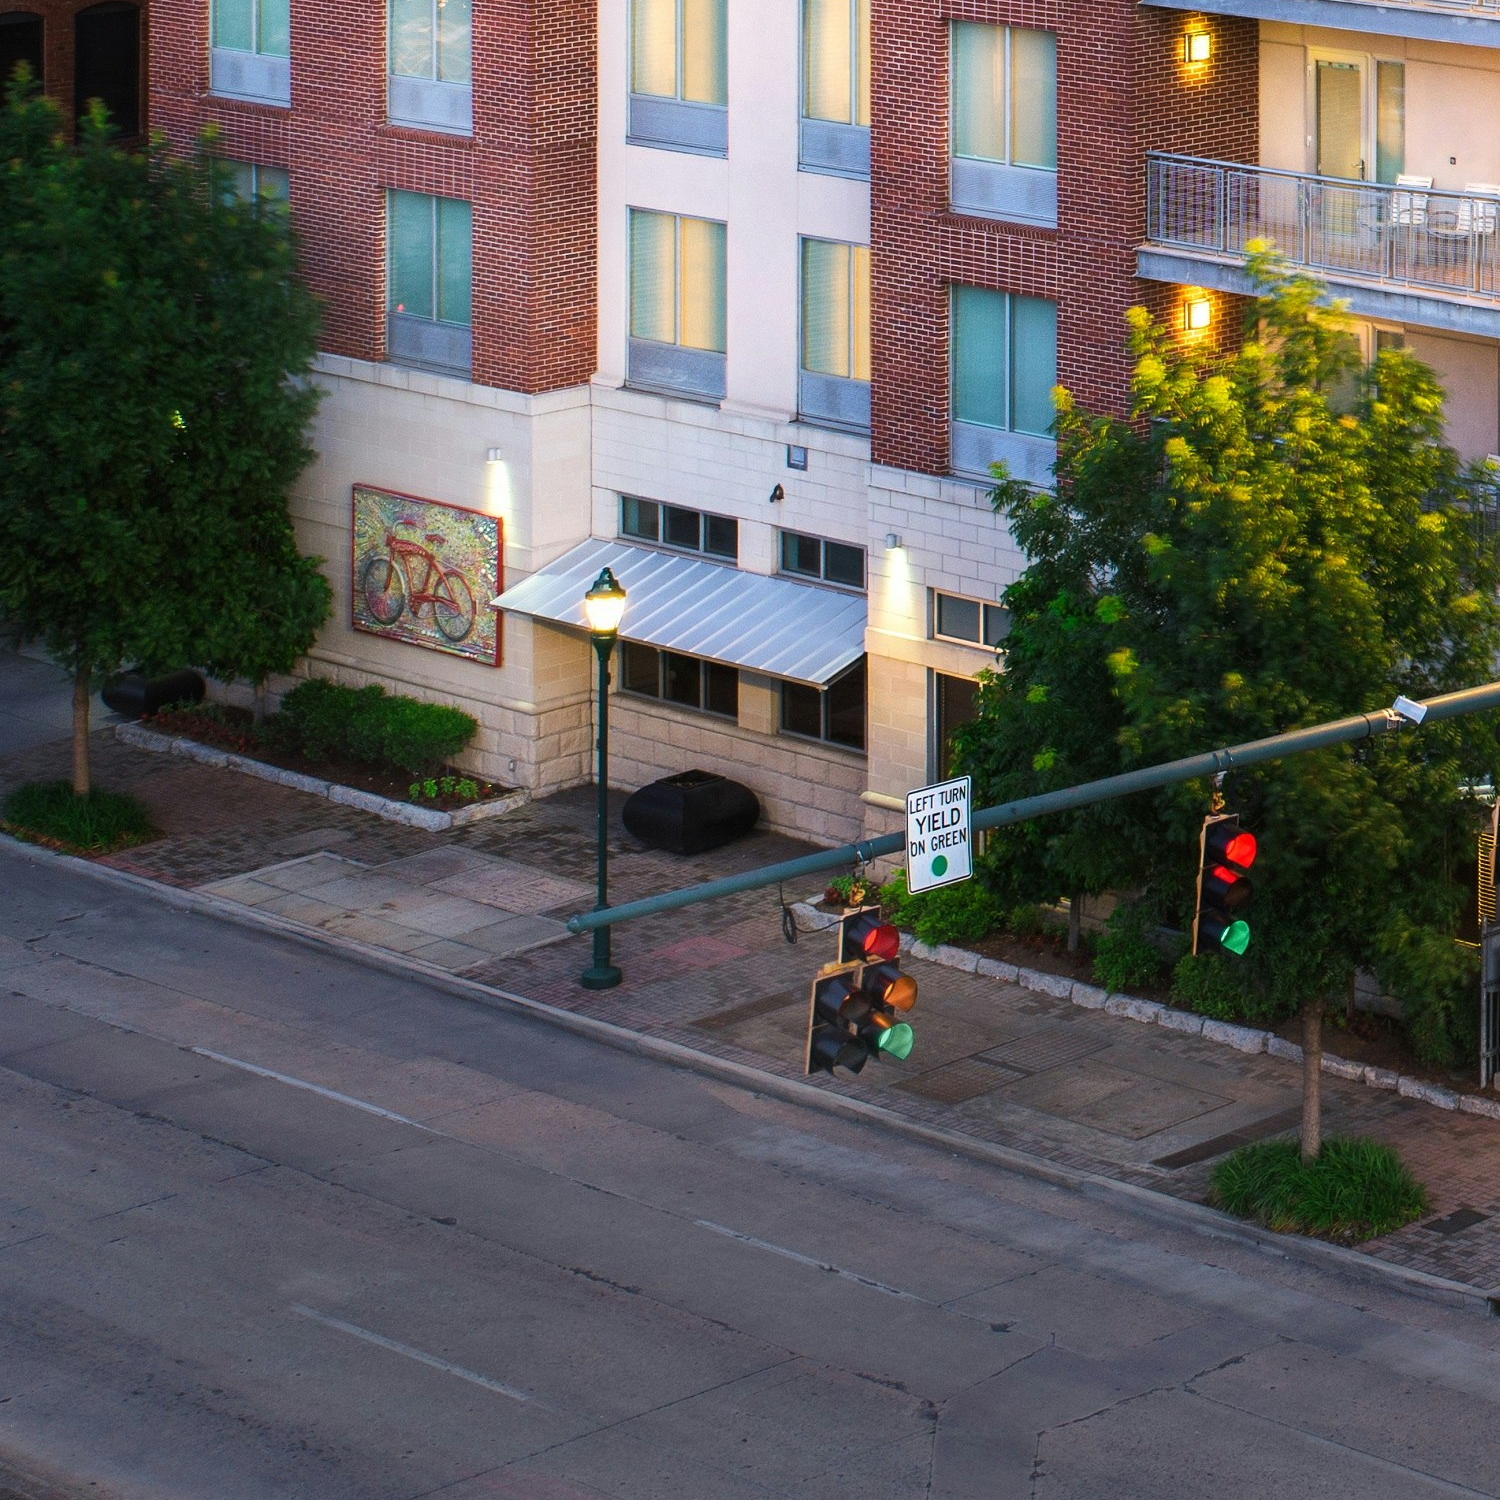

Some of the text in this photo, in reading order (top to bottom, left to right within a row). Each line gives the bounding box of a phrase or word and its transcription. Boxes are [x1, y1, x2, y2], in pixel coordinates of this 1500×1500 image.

[910, 785, 966, 815] LEFT TURN
[915, 807, 961, 835] YIELD
[910, 827, 967, 857] ON GREEN
